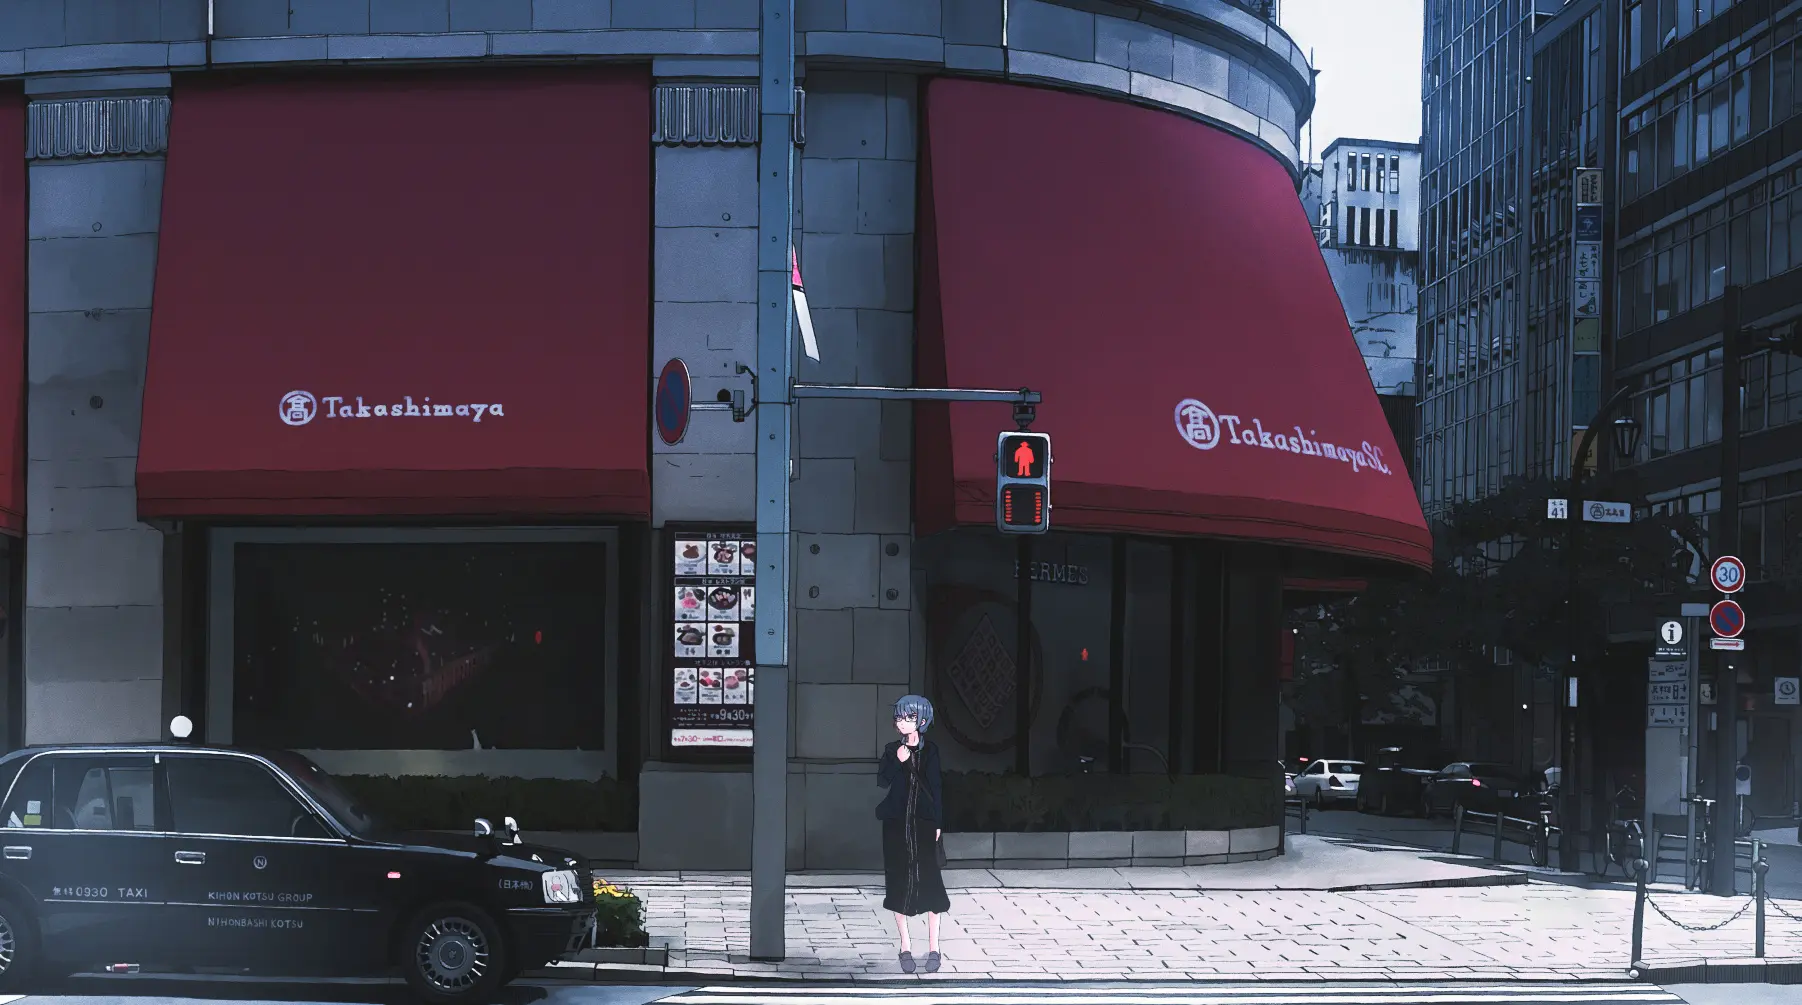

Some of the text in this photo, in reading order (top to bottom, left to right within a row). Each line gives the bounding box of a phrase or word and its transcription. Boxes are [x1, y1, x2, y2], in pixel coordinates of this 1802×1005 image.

[322, 396, 504, 423] Takashimaya
[1218, 414, 1369, 472] Takashimaya
[1551, 507, 1564, 518] 41
[1719, 566, 1738, 582] 30
[118, 888, 147, 898] TAXI
[243, 892, 274, 900] KOTSU
[278, 893, 312, 902] GROUP
[208, 917, 303, 928] NIHONBASHI KOTSU
